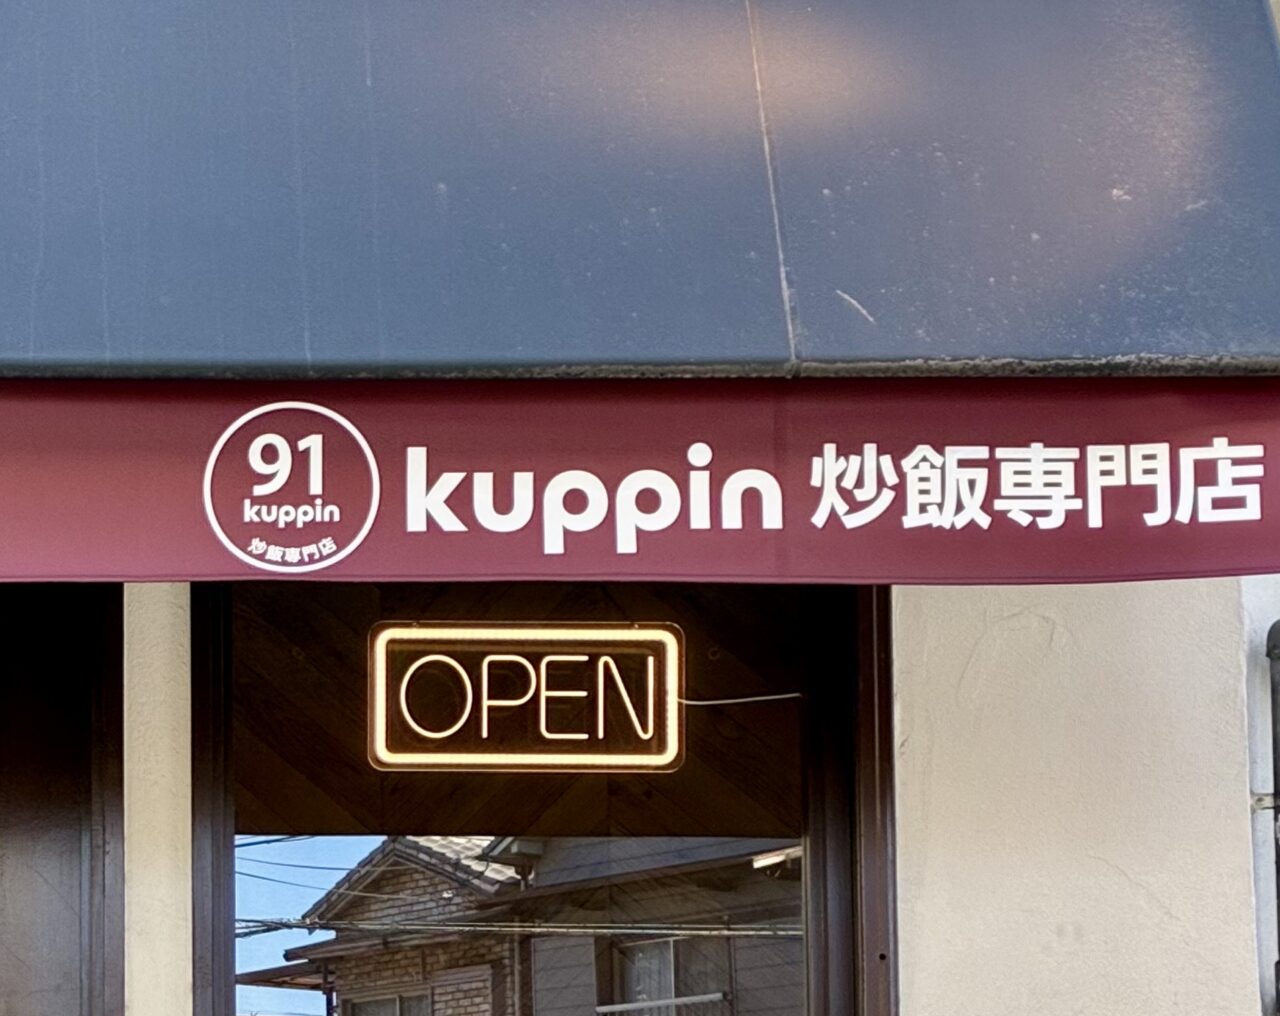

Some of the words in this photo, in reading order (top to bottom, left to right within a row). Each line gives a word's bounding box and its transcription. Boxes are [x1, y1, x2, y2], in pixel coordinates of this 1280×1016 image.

[248, 433, 324, 497] 91
[405, 441, 784, 555] kuppin
[809, 436, 1265, 530] 炒飯専門店
[243, 498, 341, 529] kuppin
[399, 653, 656, 740] OPEN
